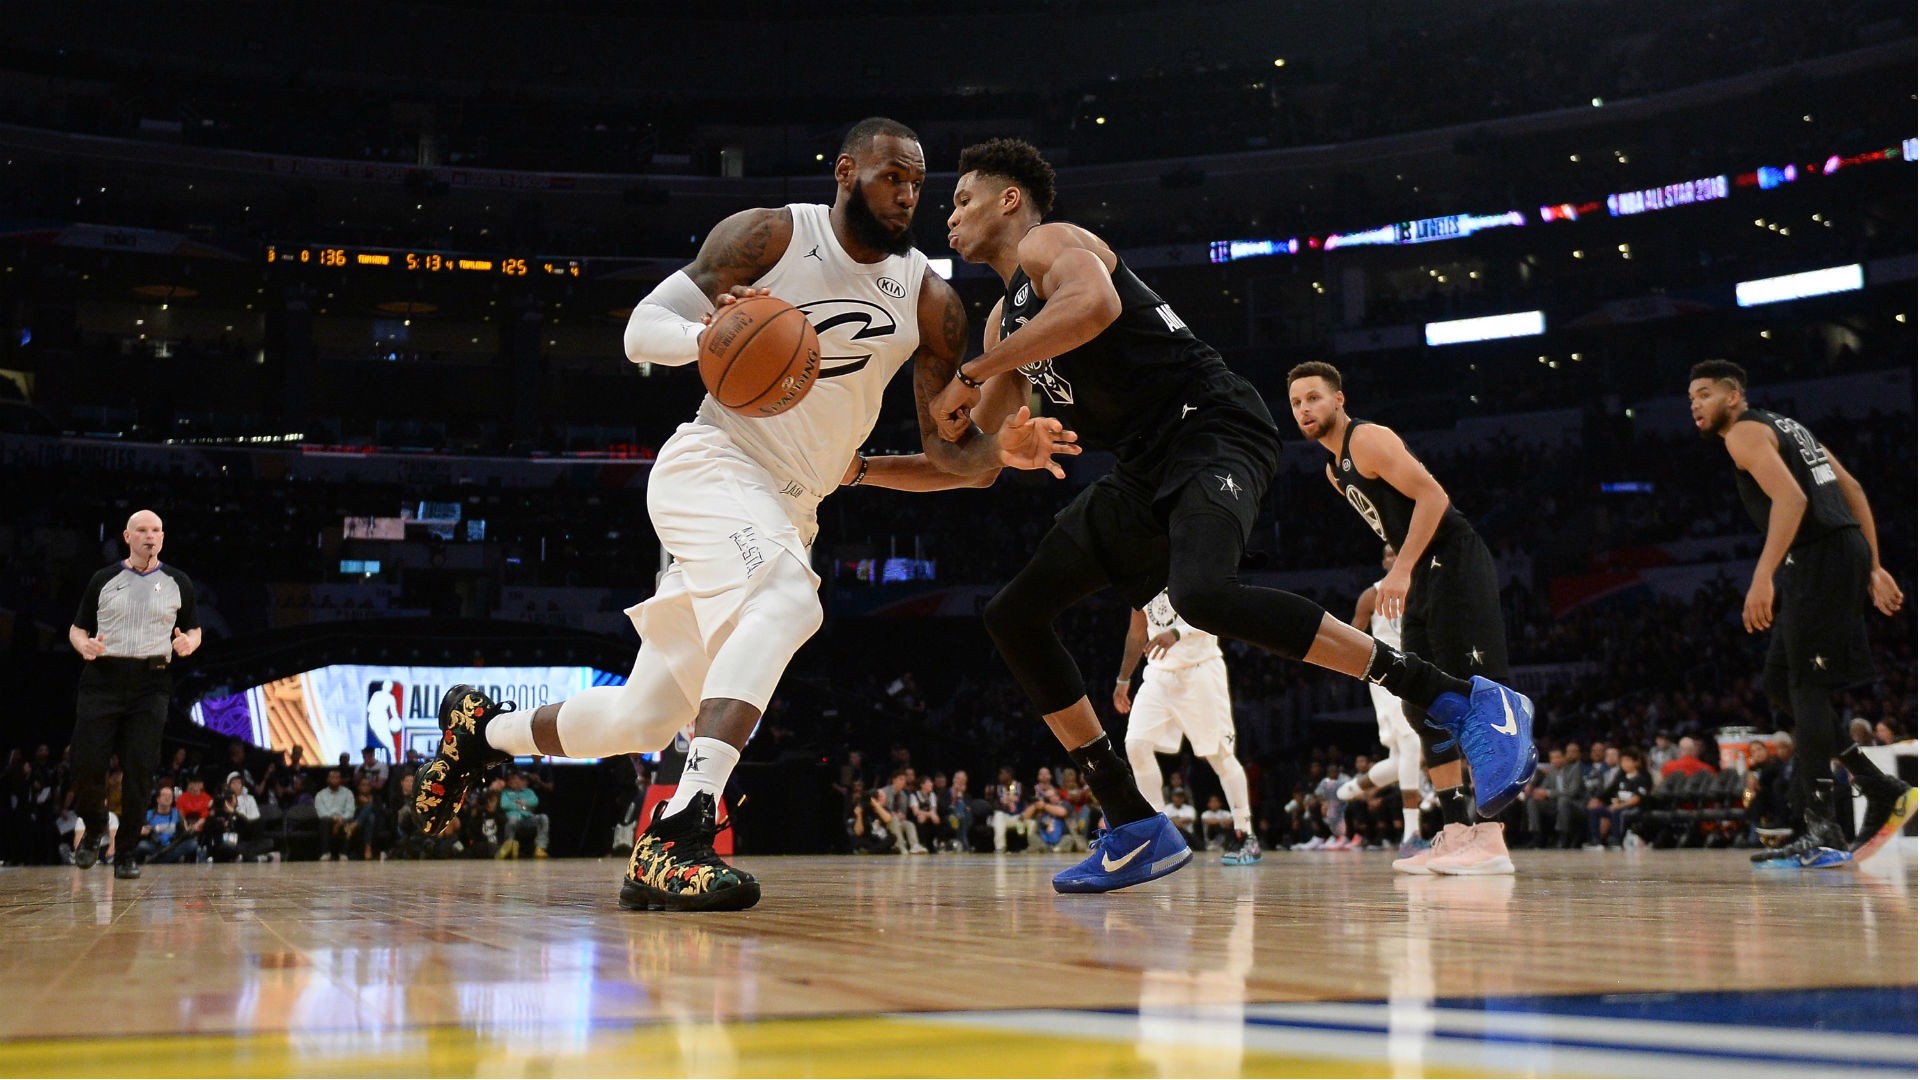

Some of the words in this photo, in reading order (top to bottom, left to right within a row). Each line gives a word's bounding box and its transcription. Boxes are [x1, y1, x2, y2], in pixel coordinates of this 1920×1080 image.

[320, 249, 346, 266] 136
[407, 253, 441, 271] 5:13
[502, 259, 528, 275] 125
